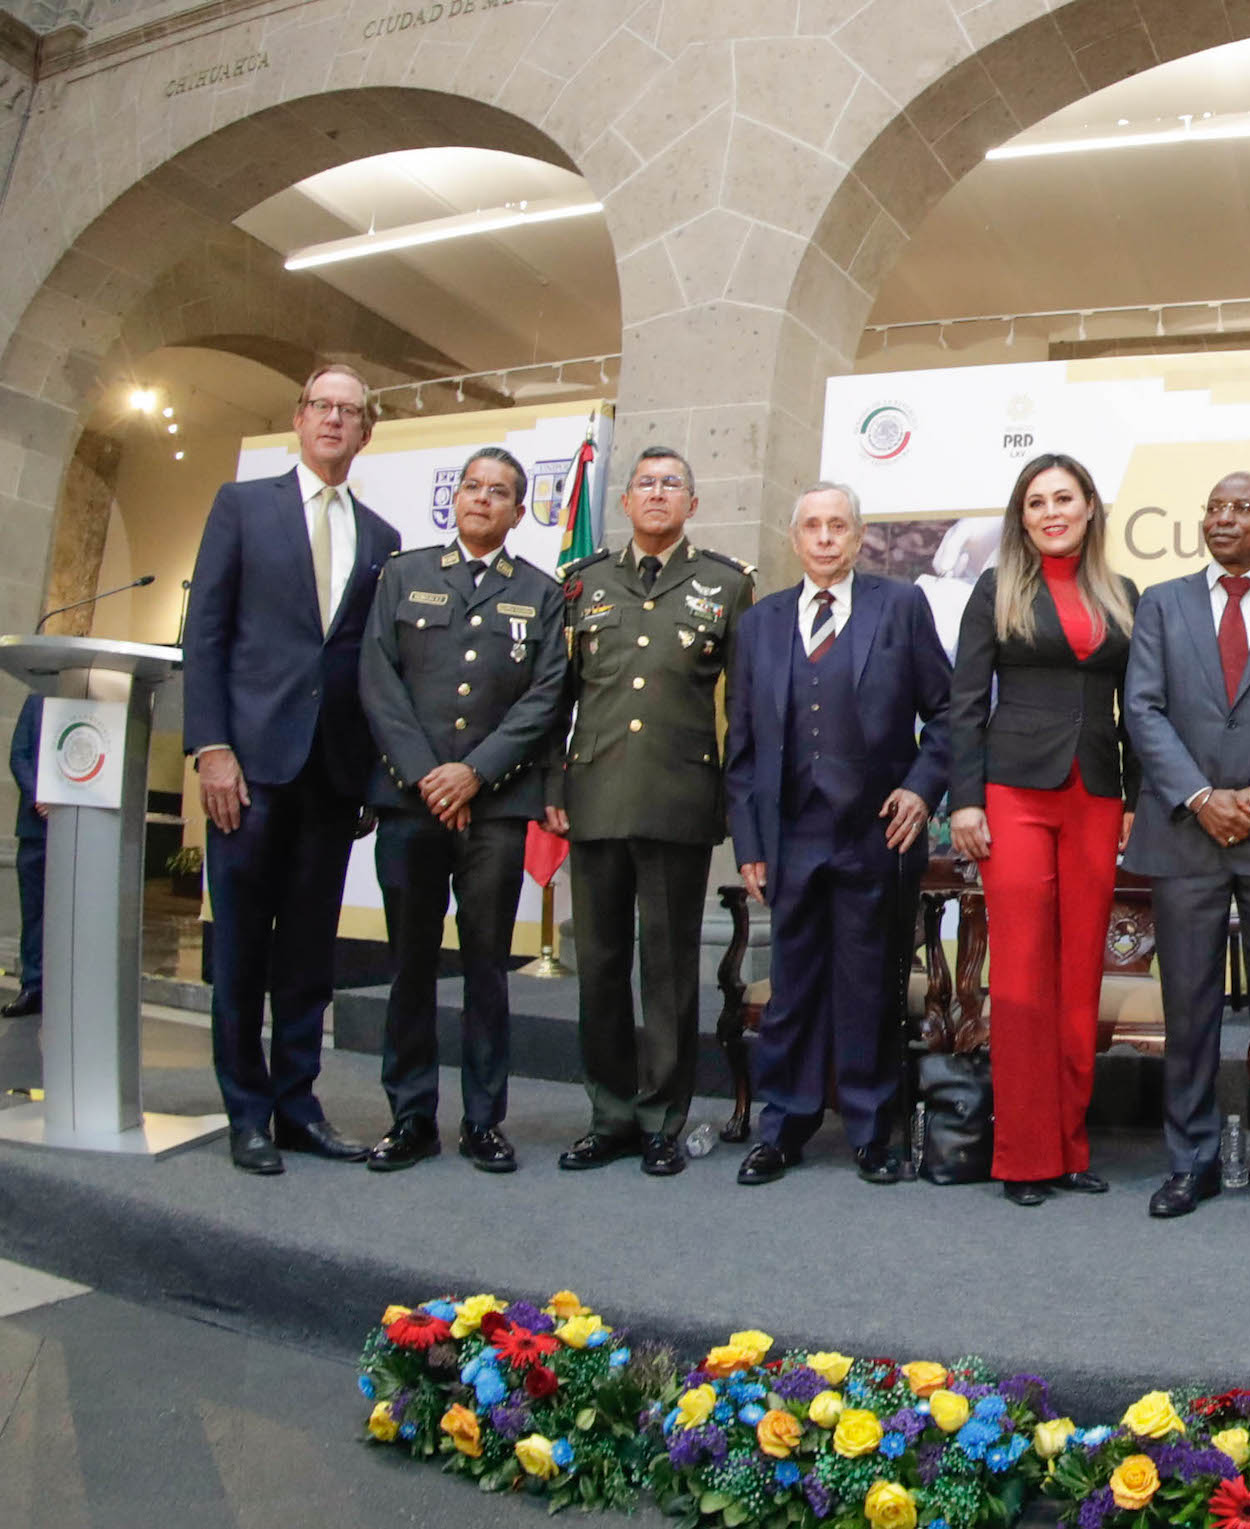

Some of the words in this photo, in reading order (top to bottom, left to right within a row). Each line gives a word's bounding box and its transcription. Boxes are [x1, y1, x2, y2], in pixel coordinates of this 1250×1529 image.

[362, 3, 443, 39] CIUDAD
[448, 0, 475, 18] DE
[164, 51, 270, 98] CHIHUAHUA
[1003, 433, 1034, 448] PRD
